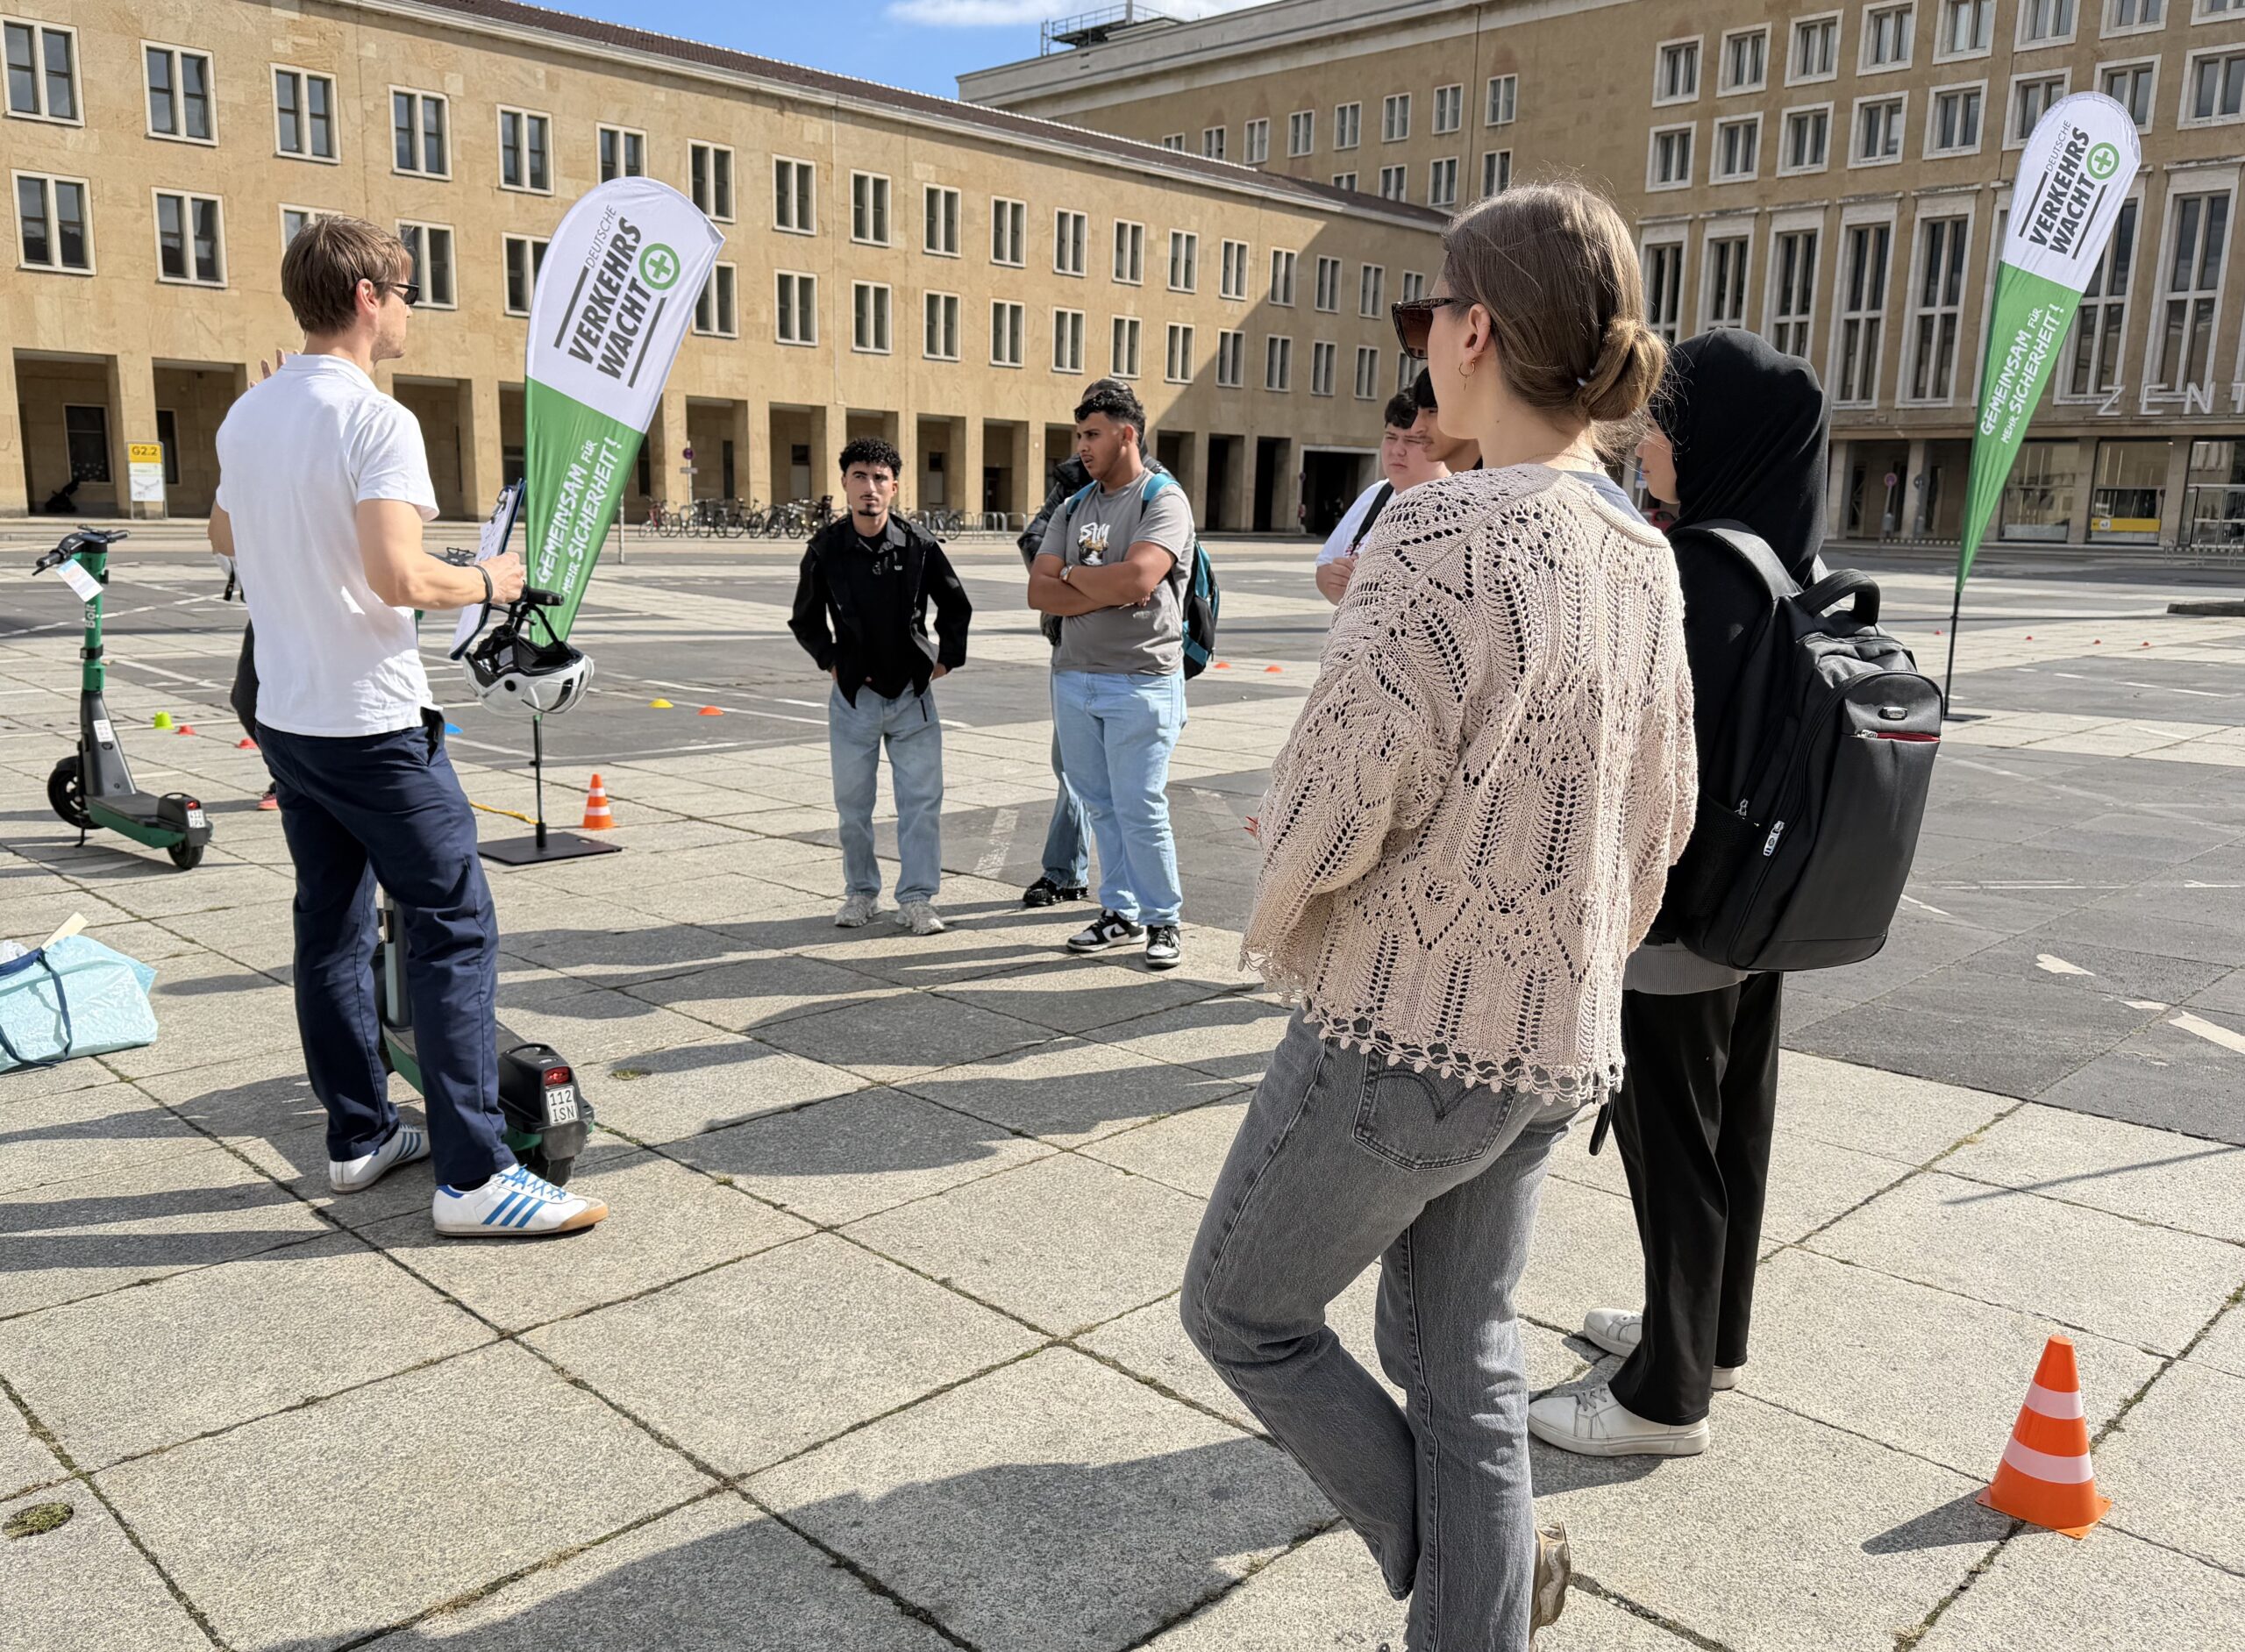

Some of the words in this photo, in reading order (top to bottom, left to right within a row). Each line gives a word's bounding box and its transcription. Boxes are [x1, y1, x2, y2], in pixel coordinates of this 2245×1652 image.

[2046, 119, 2071, 173] DEUTSCHE
[2028, 126, 2091, 246] VERKEHRS
[2049, 172, 2096, 255] WACHT
[585, 204, 617, 269] DEUTSCHE
[568, 217, 642, 365] VERKEHRS
[596, 276, 652, 380] WACHT
[1980, 329, 2033, 436] GEMEINSAM
[2028, 308, 2043, 329] FÜR
[2008, 303, 2064, 414] SICHERHEIT!
[132, 445, 158, 456] G2.2
[2000, 416, 2020, 444] MEHR
[536, 462, 588, 584] GEMEINSAM
[581, 439, 598, 464] FÜR
[567, 437, 622, 561] SICHERHEIT!
[561, 561, 581, 594] MEHR
[84, 603, 96, 629] Bolt
[550, 1089, 572, 1107] 112
[552, 1106, 575, 1122] ISN
